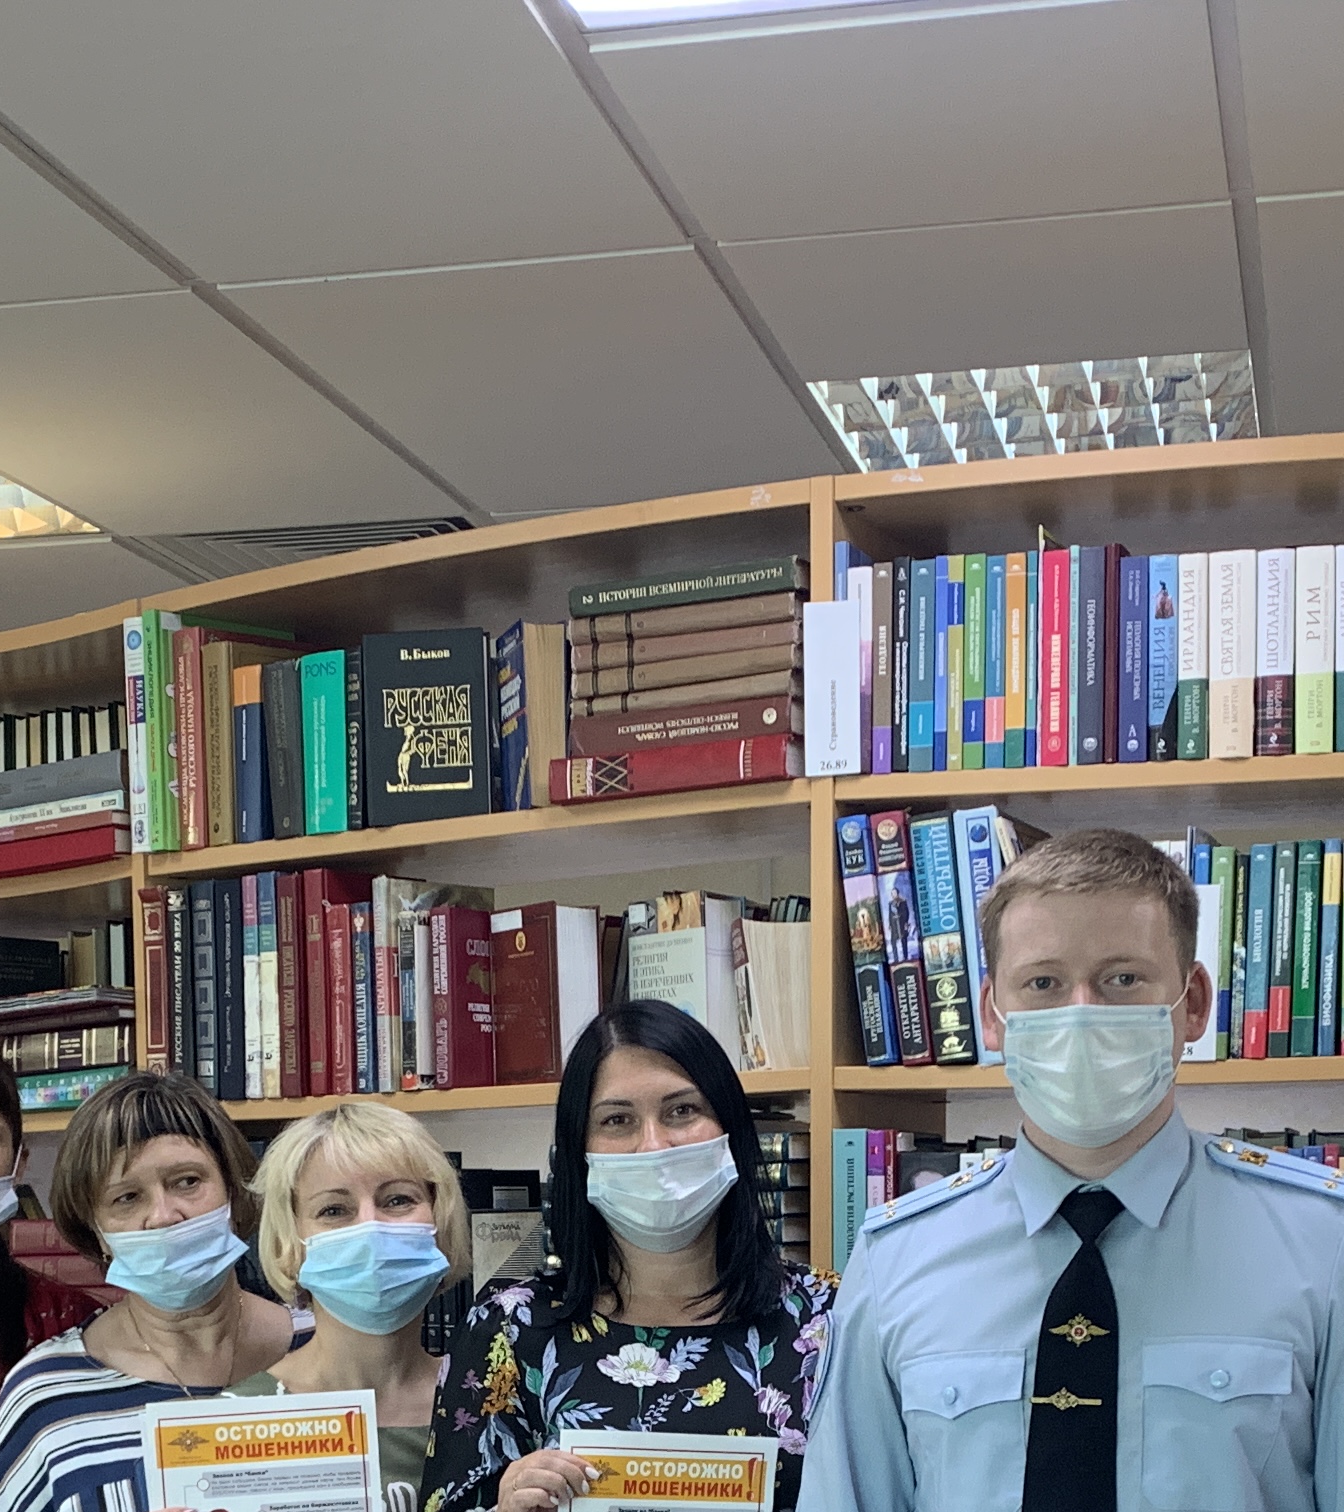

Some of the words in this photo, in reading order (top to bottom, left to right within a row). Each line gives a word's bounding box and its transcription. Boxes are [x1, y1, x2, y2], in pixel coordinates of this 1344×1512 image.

[1181, 568, 1196, 672] ИРЛАНДИЯ
[1266, 557, 1282, 669] ШОТЛАНДИЯ
[1306, 586, 1321, 641] РИМ
[304, 660, 337, 679] PONS
[382, 683, 472, 727] РУССКАЯ
[415, 728, 473, 769] ФЕНЯ
[819, 760, 848, 771] 26.89
[930, 822, 957, 931] ОТКРЫТИЙ
[897, 983, 911, 1039] ОТКРЫТИЕ
[906, 974, 922, 1044] АНТАРКТИДЫ
[215, 1419, 341, 1442] ОСТОРОЖНО
[215, 1438, 344, 1460] МОШЕННИКИ
[623, 1479, 743, 1498] МОШЕННИКИ
[626, 1460, 743, 1479] ОСТОРОЖНО
